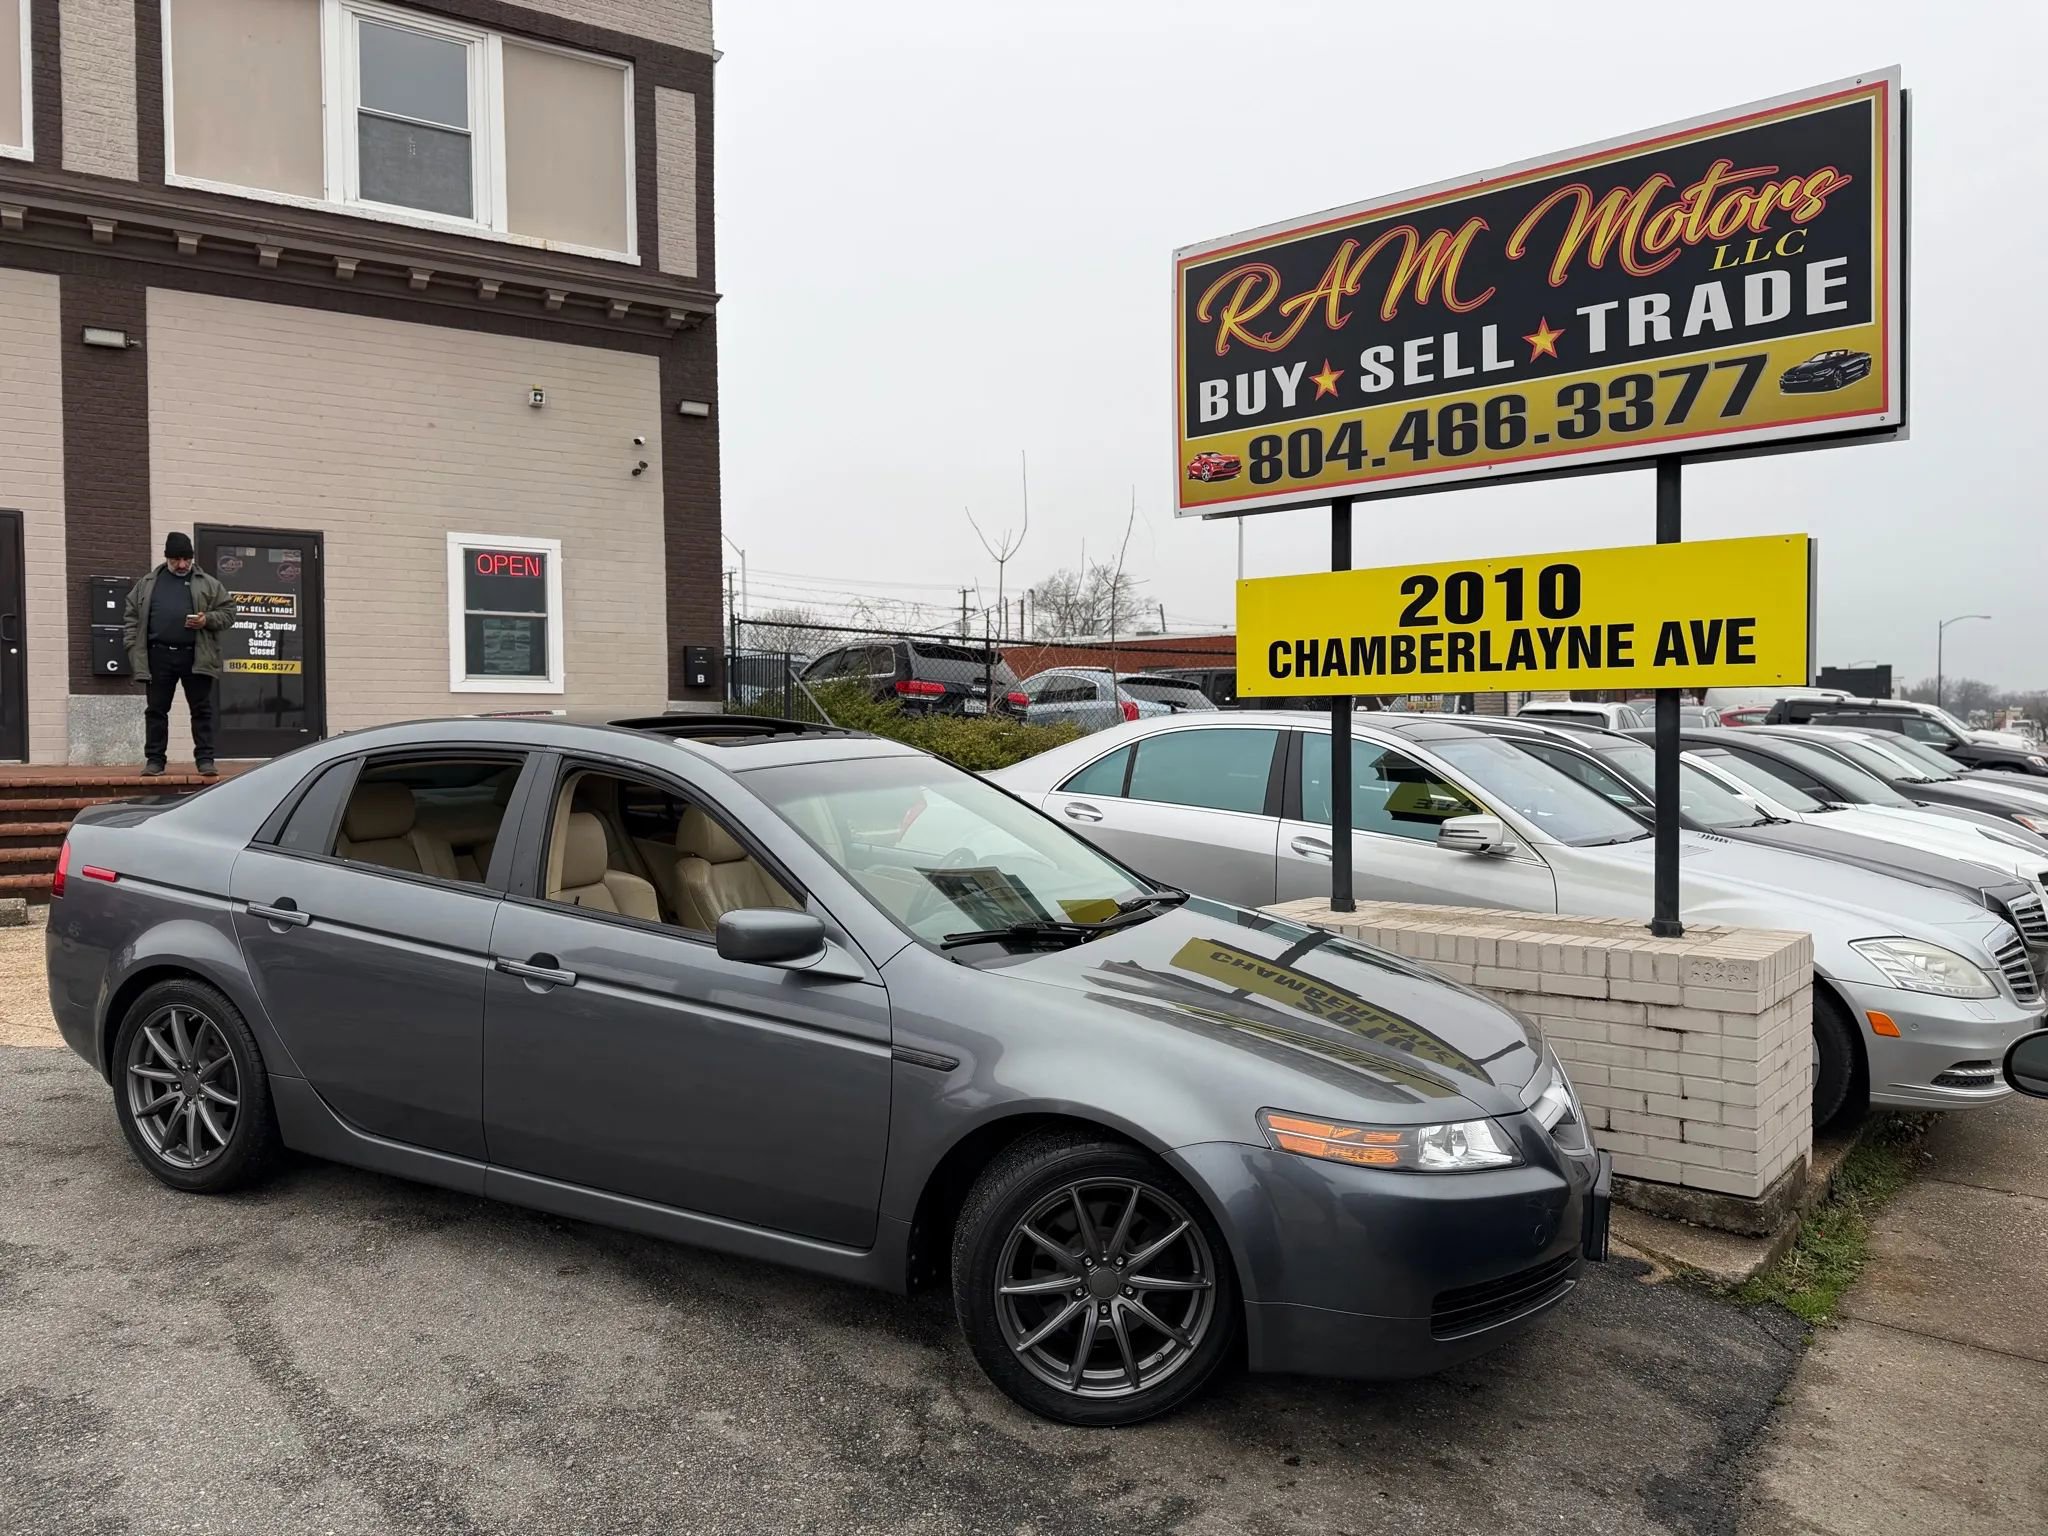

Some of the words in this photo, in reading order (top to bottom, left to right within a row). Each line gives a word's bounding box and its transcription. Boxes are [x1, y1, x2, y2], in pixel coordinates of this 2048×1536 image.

[1197, 216, 1496, 356] RAM
[1506, 159, 1853, 287] Motors
[1708, 228, 1809, 272] LLC
[1199, 362, 1307, 423] BUY
[1360, 333, 1515, 394] SELL
[1577, 257, 1848, 354] TRADE
[1246, 352, 1771, 486] 804.466.3377
[477, 553, 540, 577] OPEN
[1398, 563, 1582, 628] 2010
[236, 605, 247, 613] UY
[231, 621, 258, 630] onday
[263, 621, 296, 631] Saturday
[254, 630, 271, 638] 12-5
[248, 638, 276, 647] Sunday
[249, 647, 275, 655] Closed
[1268, 623, 1635, 679] CHAMBERLAYNE
[1652, 617, 1757, 667] AVE
[106, 660, 118, 672] C
[697, 674, 705, 684] B
